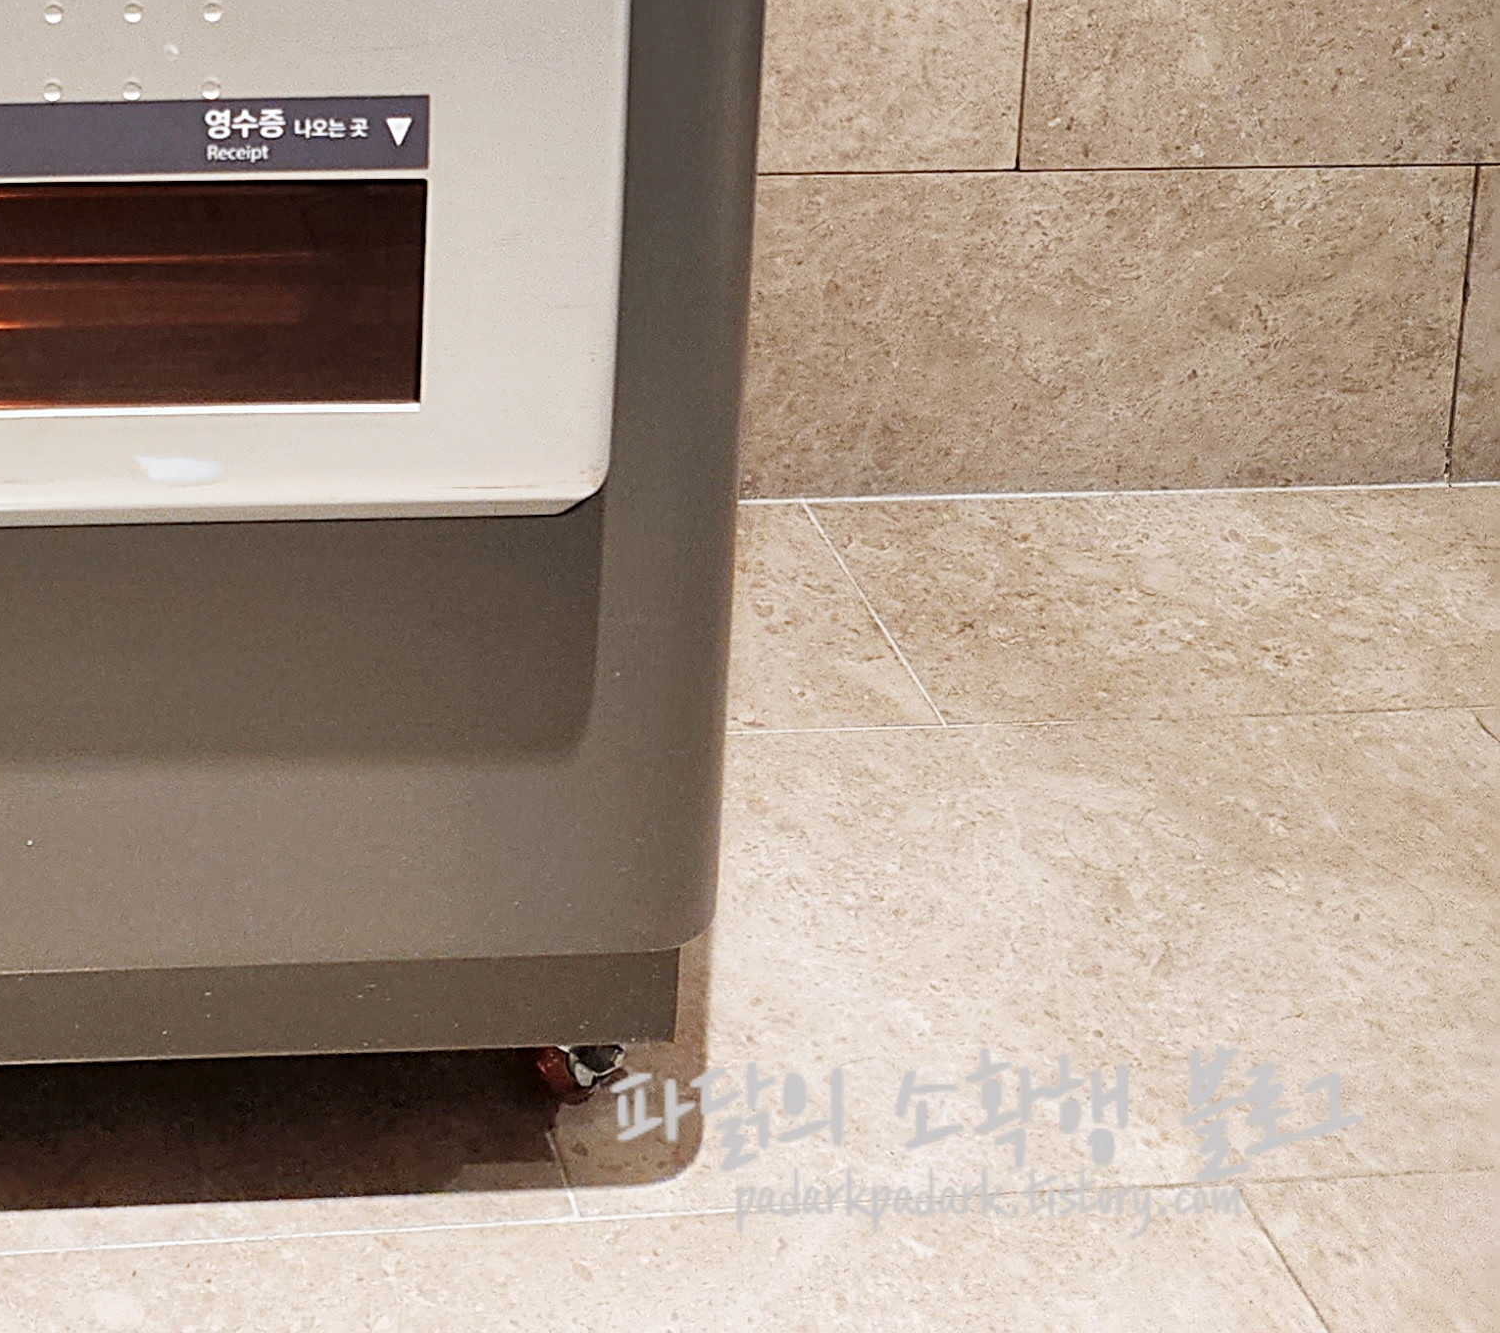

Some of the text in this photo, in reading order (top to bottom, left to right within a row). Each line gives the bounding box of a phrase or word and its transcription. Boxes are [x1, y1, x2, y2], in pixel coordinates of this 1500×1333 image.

[204, 109, 369, 139] 영수증 나오는 곳
[207, 145, 268, 163] Receipt
